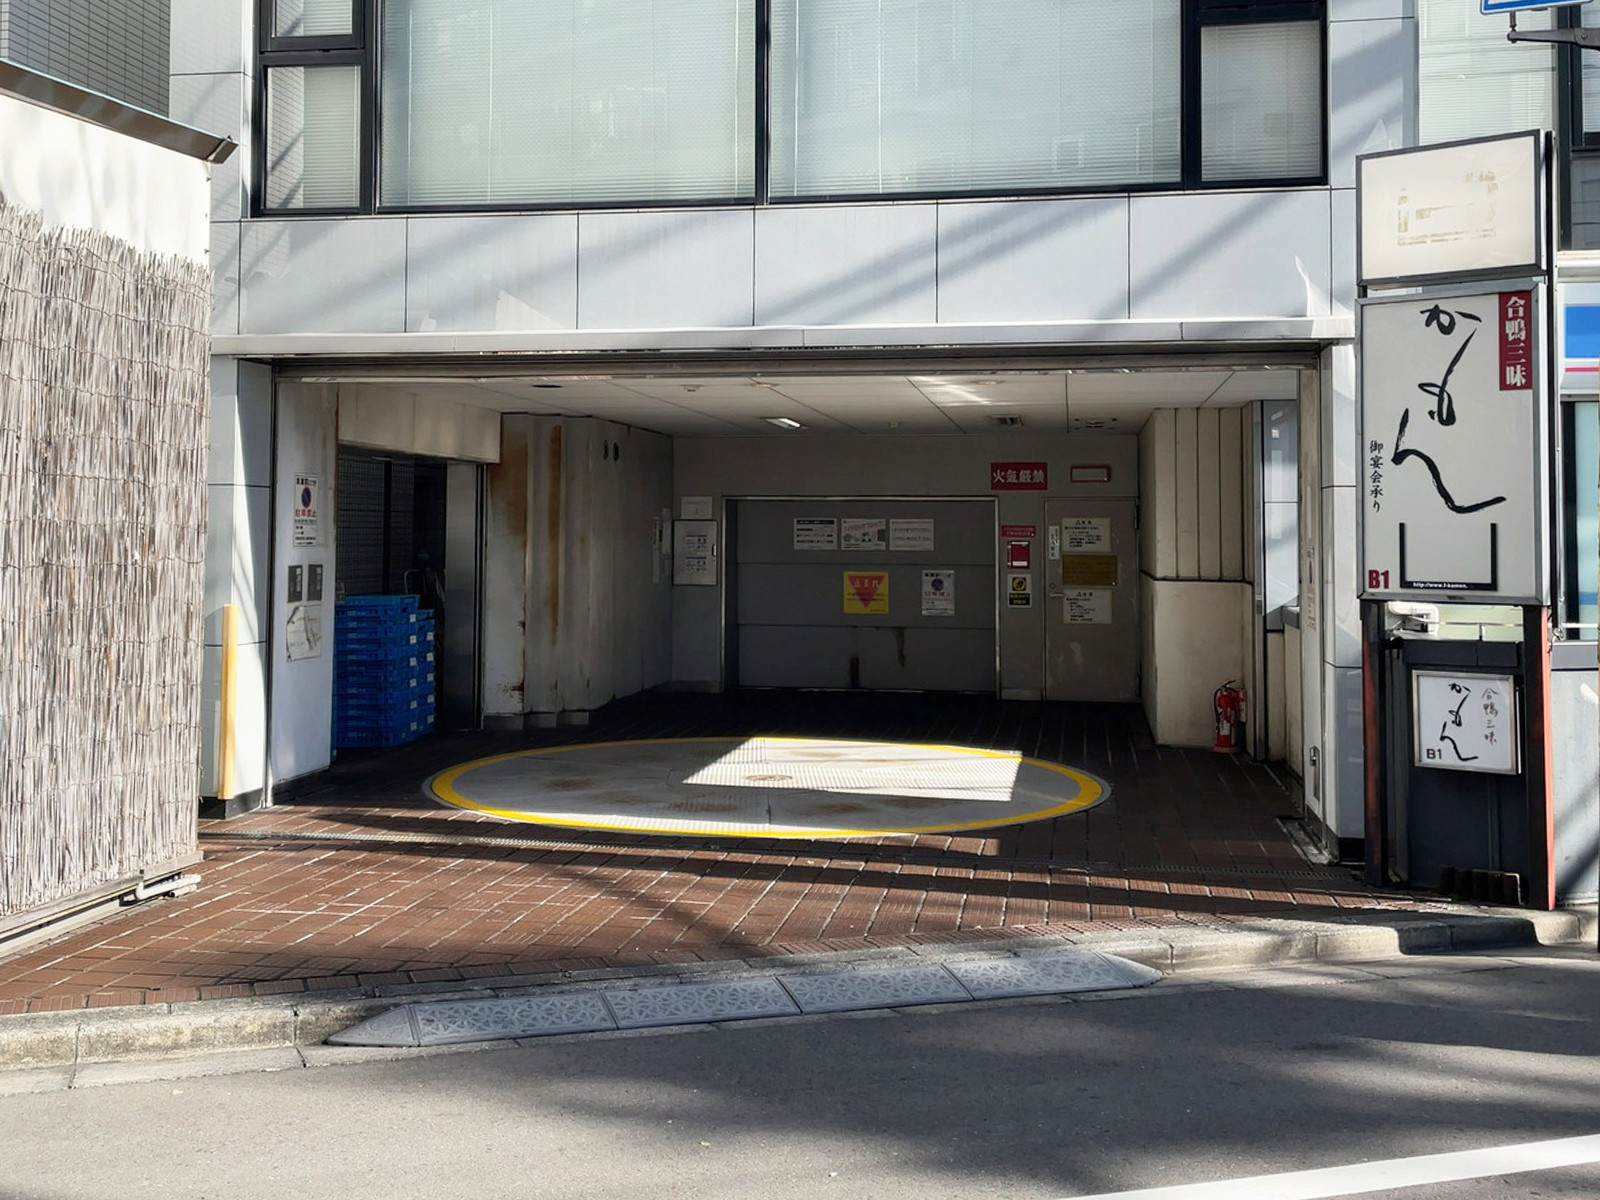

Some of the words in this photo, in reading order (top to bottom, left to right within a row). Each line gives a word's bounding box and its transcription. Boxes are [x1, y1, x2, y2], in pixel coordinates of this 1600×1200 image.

[1506, 296, 1527, 387] 合鴨三味
[992, 468, 1045, 484] 火気厳禁
[1369, 439, 1384, 513] 御宴会承り
[1368, 569, 1390, 589] B1
[1481, 687, 1499, 746] 合鴨三味
[1426, 748, 1442, 760] B1
